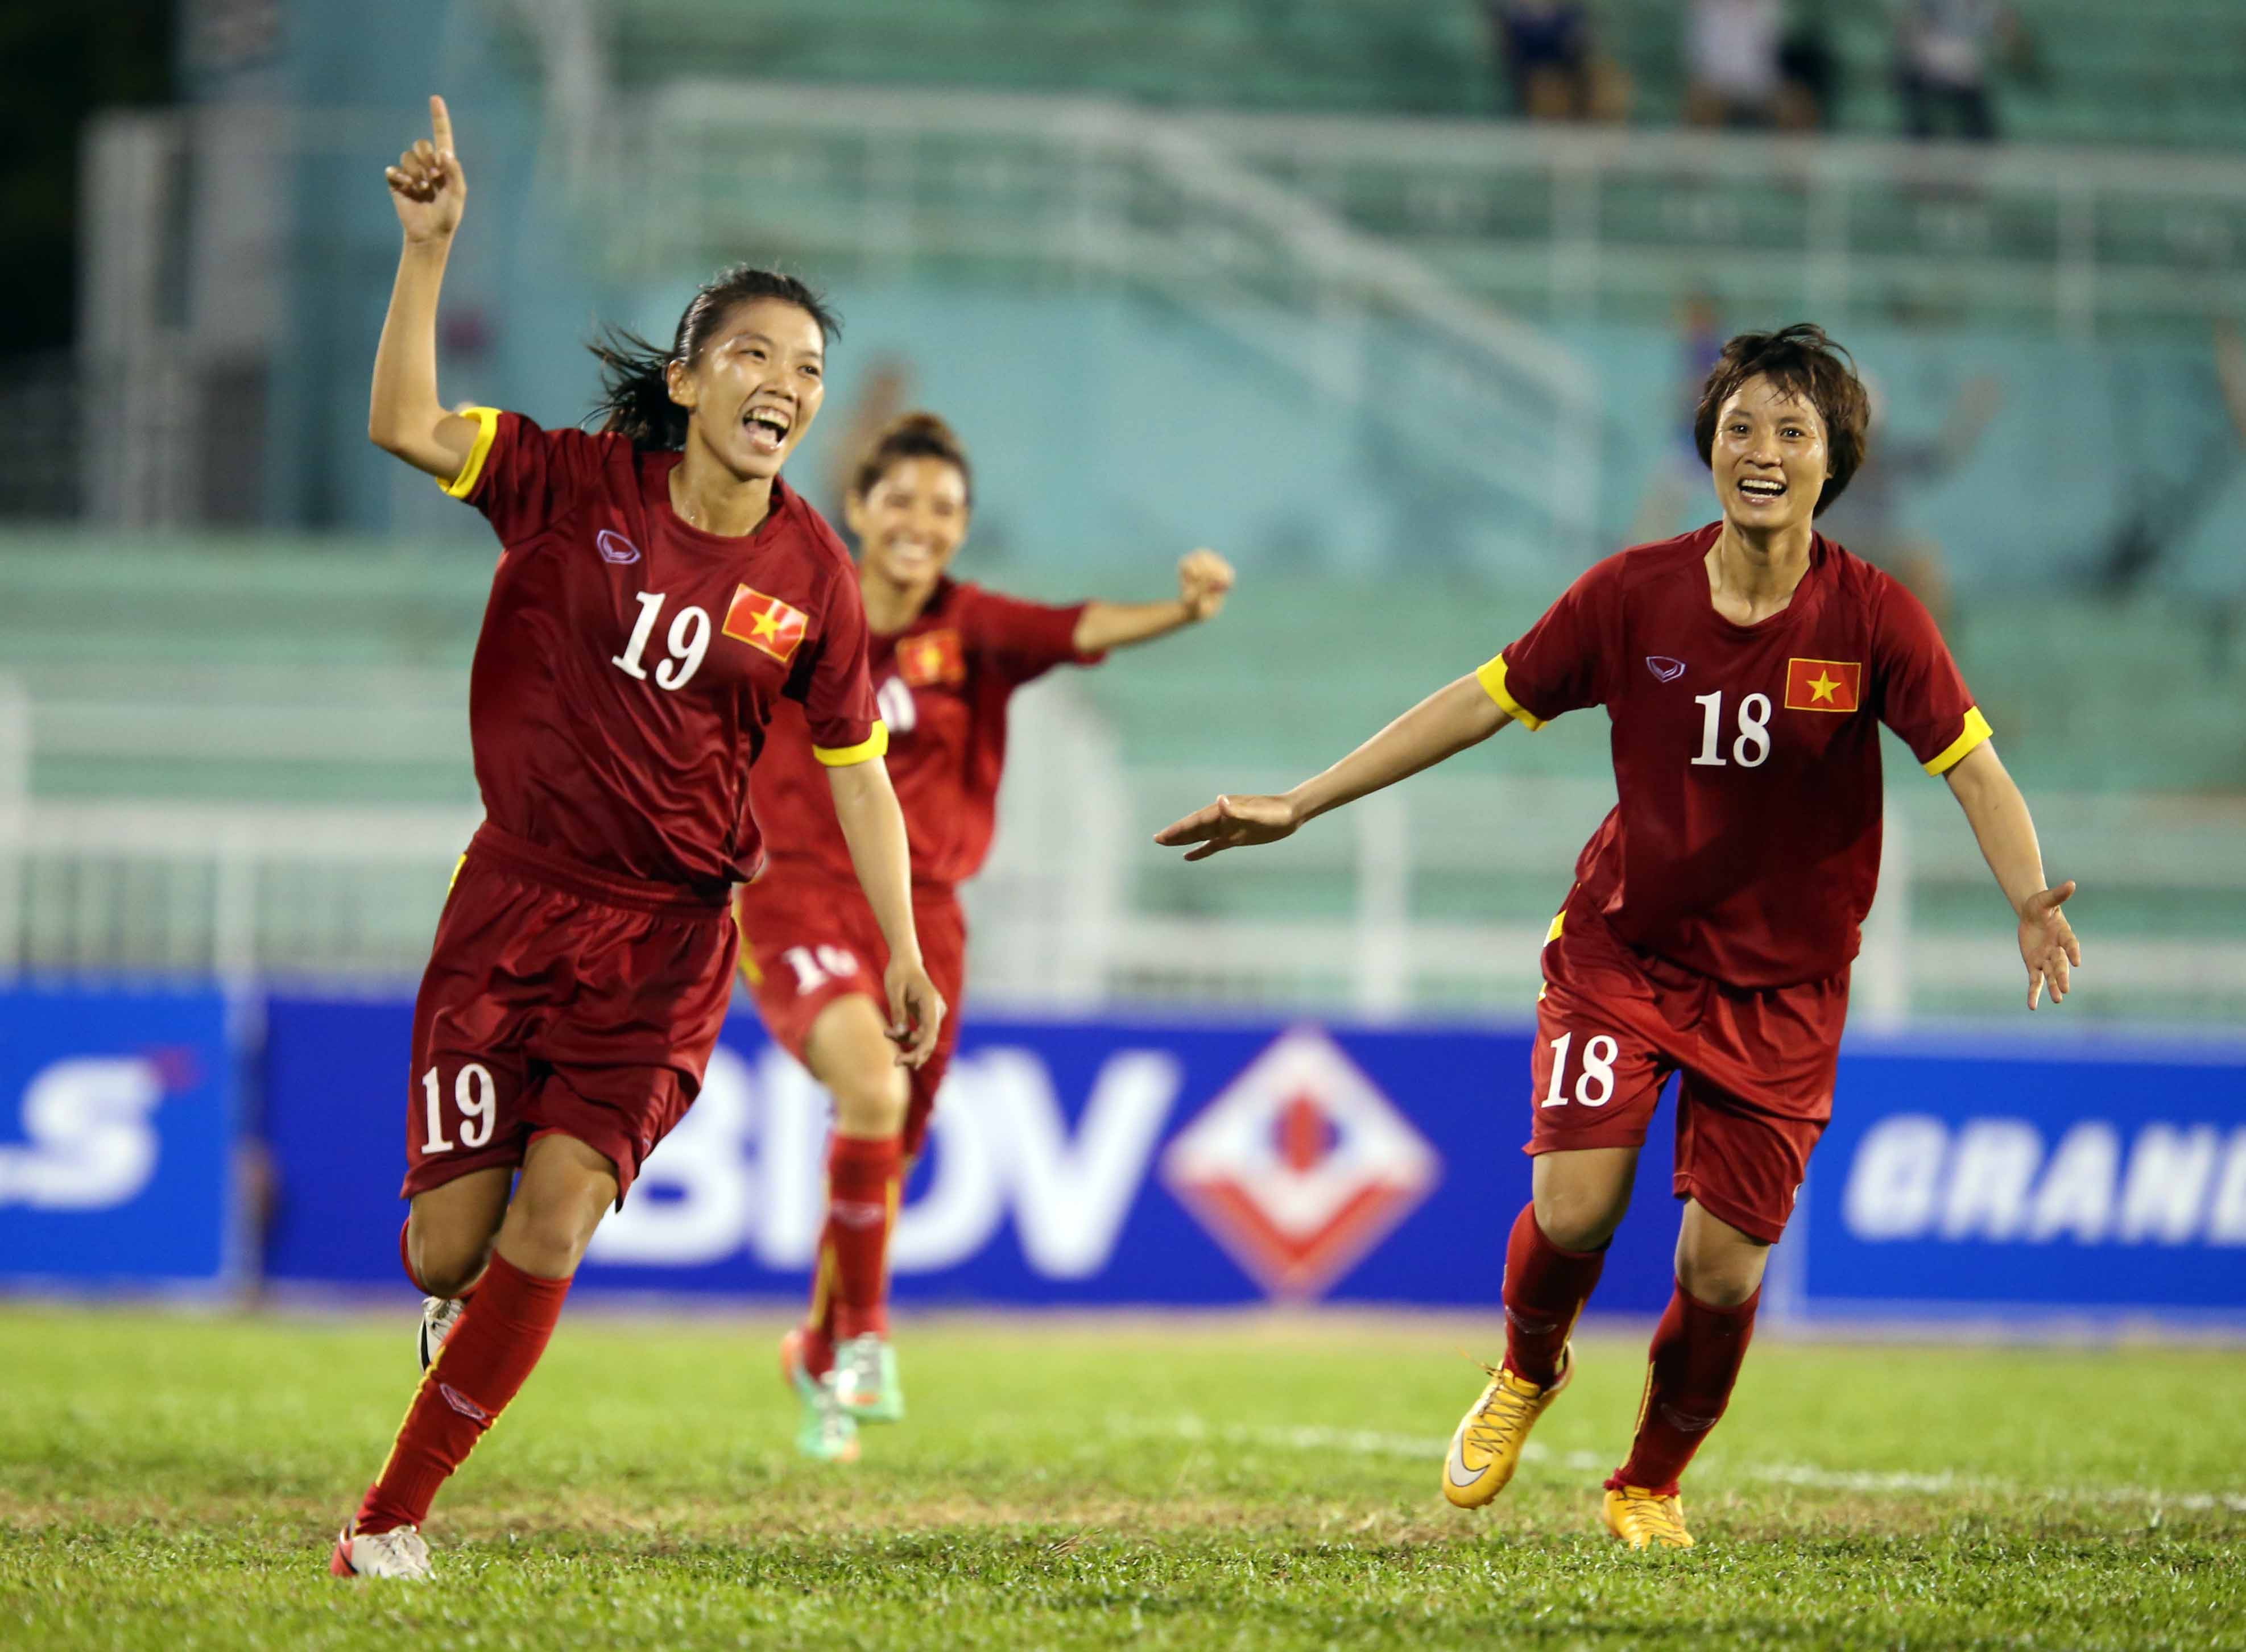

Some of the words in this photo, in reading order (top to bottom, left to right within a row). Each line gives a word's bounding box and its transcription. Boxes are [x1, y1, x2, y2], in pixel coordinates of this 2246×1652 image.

[611, 591, 712, 691] 19
[1690, 690, 1772, 767] 18
[421, 1062, 496, 1154] 19
[1541, 1031, 1619, 1109] 18
[0, 1054, 162, 1209] S
